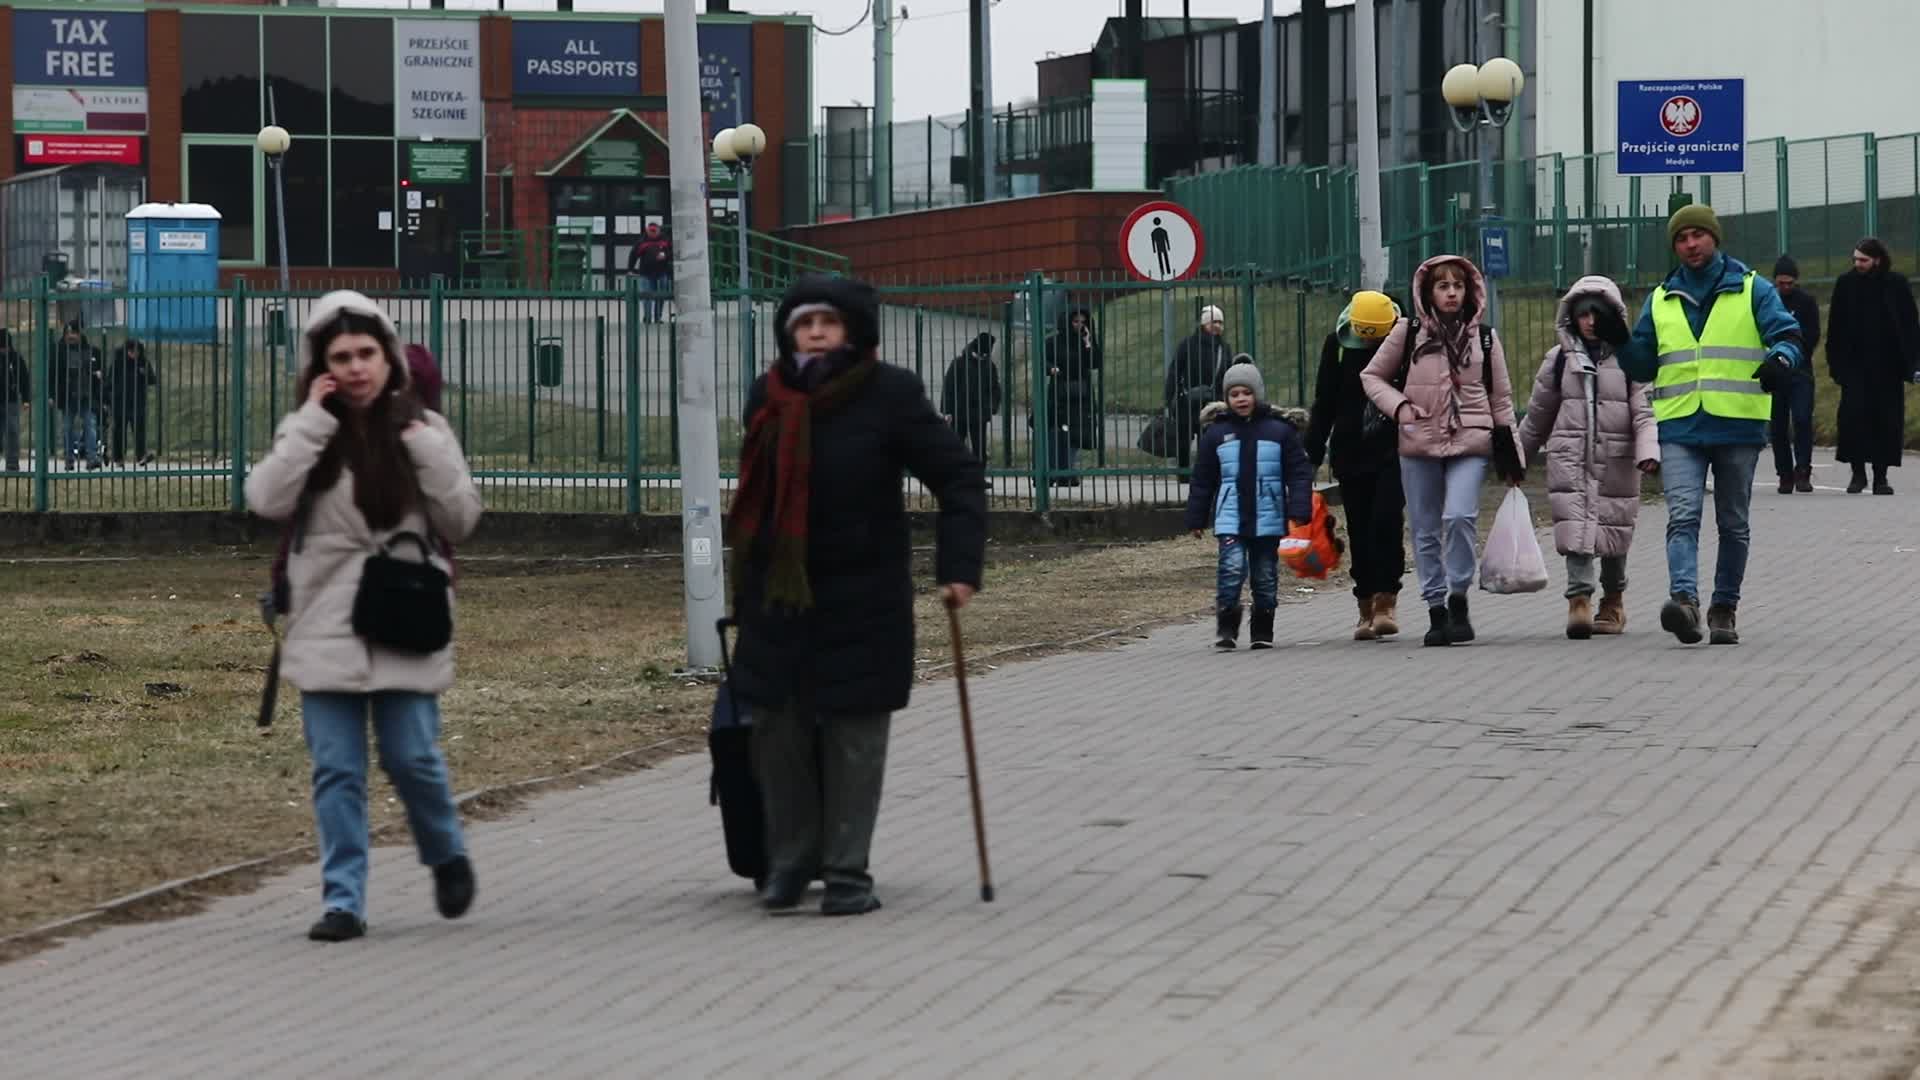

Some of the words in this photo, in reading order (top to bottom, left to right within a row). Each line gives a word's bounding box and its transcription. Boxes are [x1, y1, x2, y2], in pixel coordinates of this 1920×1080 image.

[51, 18, 108, 45] TAX
[409, 36, 469, 50] PRZEJŚCIE
[564, 39, 601, 55] ALL
[46, 51, 115, 77] FREE
[404, 56, 473, 68] GRANICZNE
[527, 59, 638, 77] PASSPORTS
[703, 64, 720, 76] EU
[1639, 84, 1695, 92] Rzeczpospolita
[412, 107, 468, 120] SZEGINIE
[1621, 141, 1675, 155] Przejście
[1678, 140, 1740, 155] graniczne
[1665, 158, 1695, 166] Medyka
